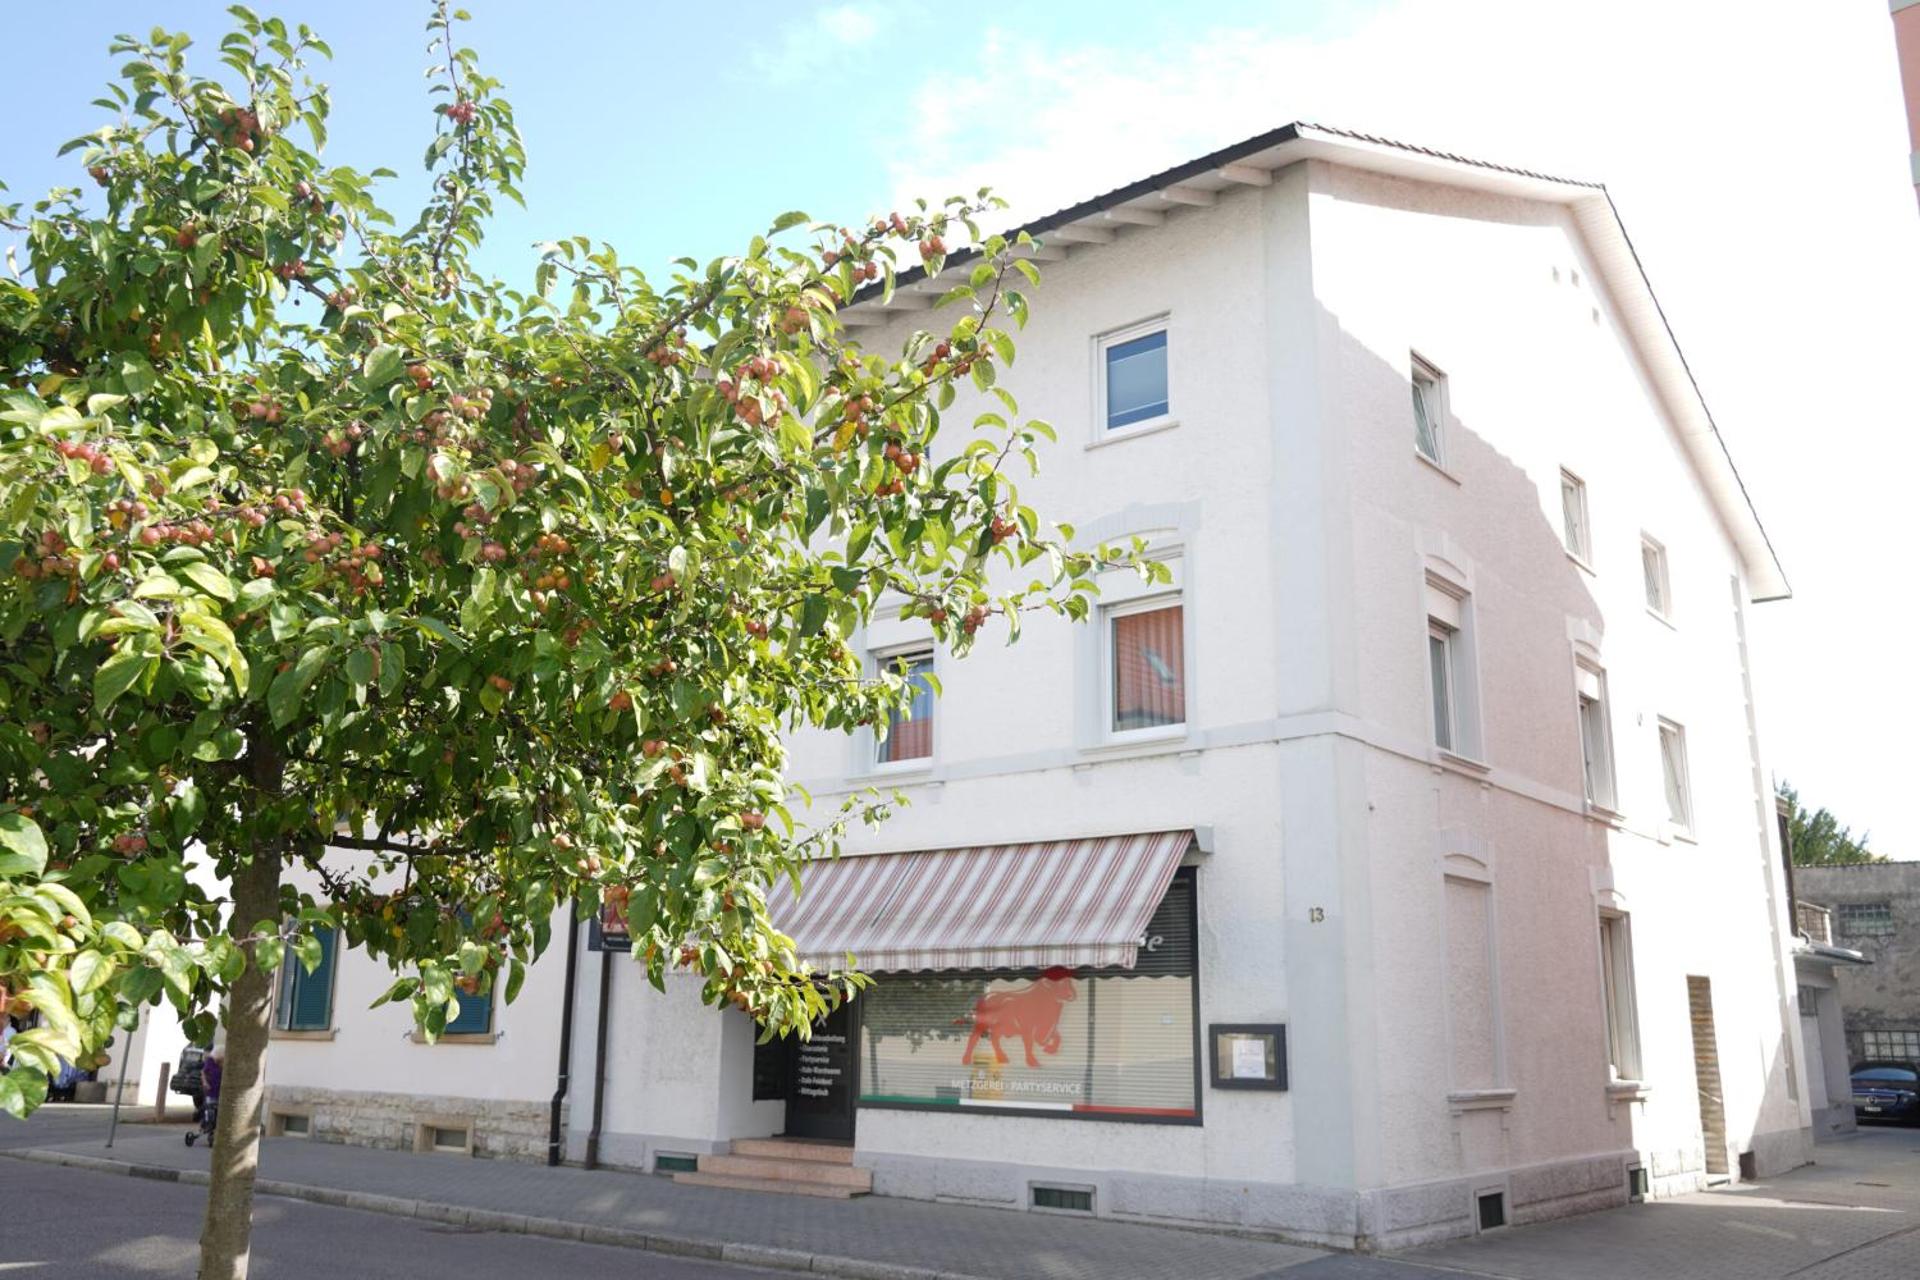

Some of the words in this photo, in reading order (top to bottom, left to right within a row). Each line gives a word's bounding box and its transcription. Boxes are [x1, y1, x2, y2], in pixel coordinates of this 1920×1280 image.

[1309, 906, 1325, 923] 13
[951, 1079, 1004, 1091] METZGEREI
[1010, 1081, 1082, 1095] PARTYSERVICE
